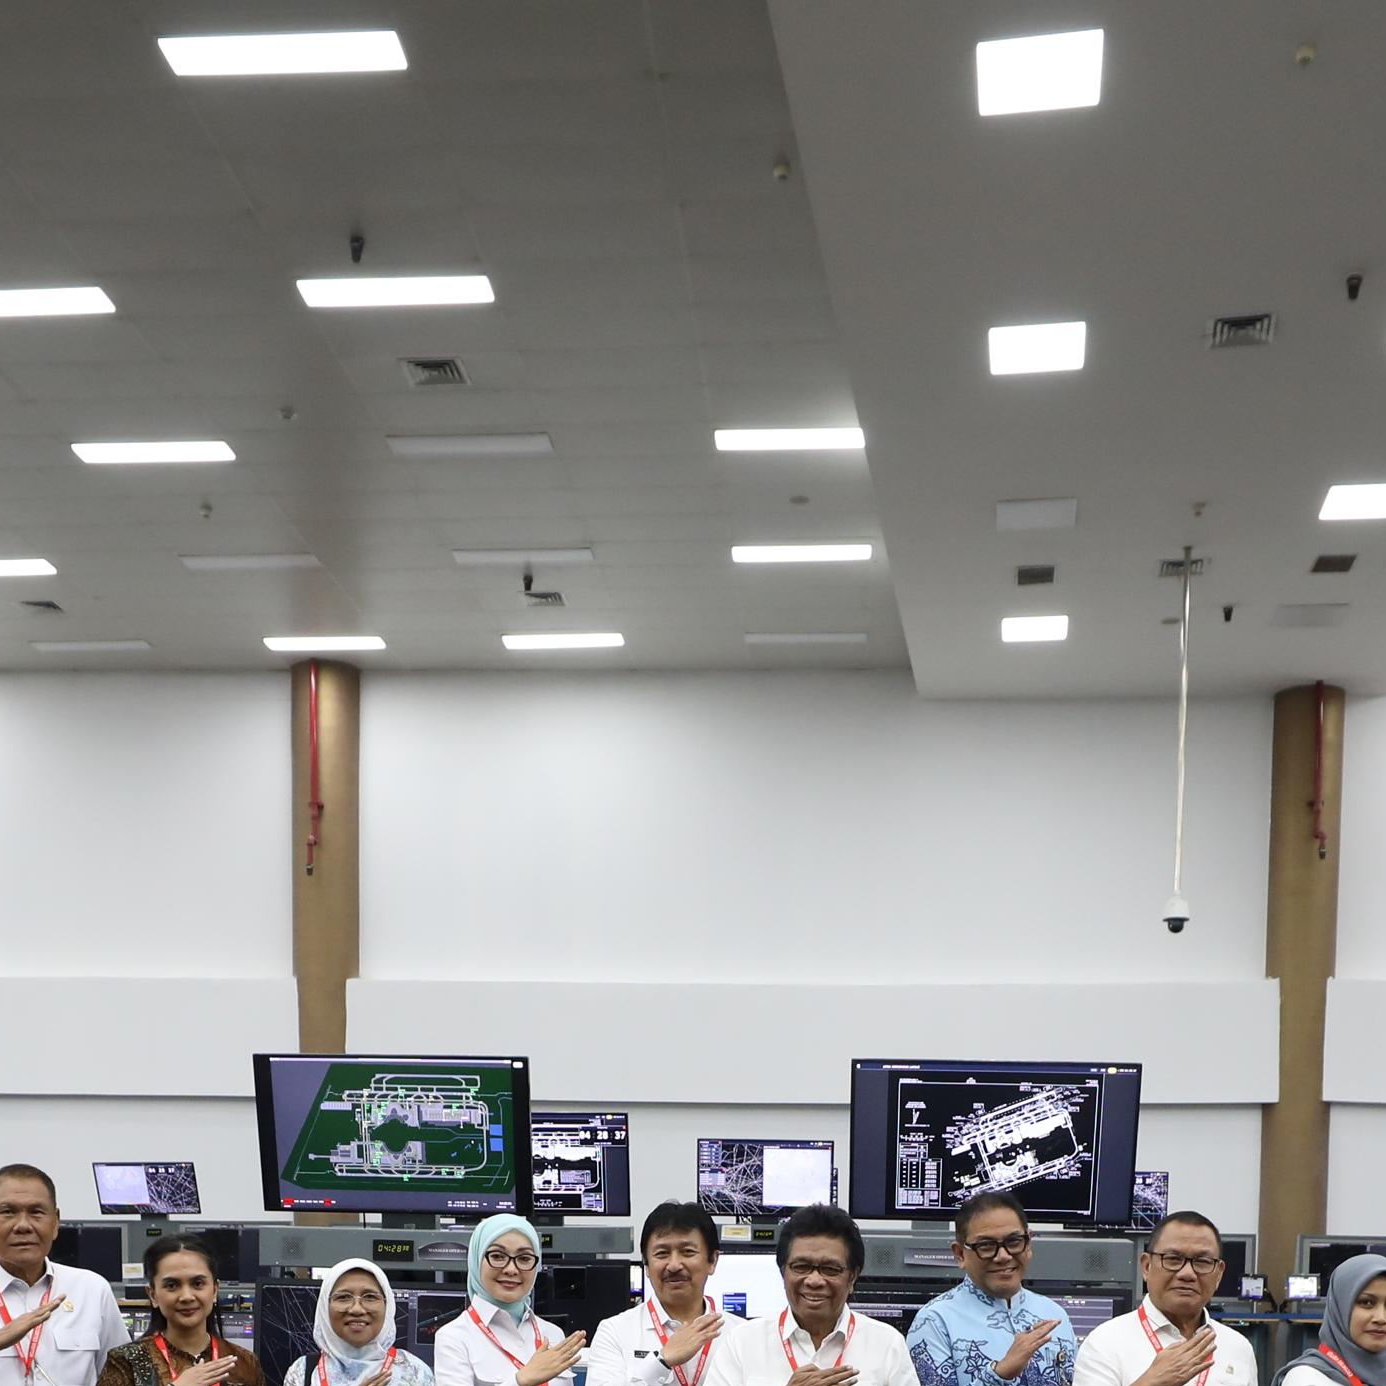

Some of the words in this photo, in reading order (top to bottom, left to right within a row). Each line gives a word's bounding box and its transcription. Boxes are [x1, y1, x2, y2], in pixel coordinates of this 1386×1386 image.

[579, 1130, 591, 1140] 04
[596, 1130, 609, 1140] 28
[614, 1130, 627, 1140] 37
[377, 1243, 402, 1252] 04:28
